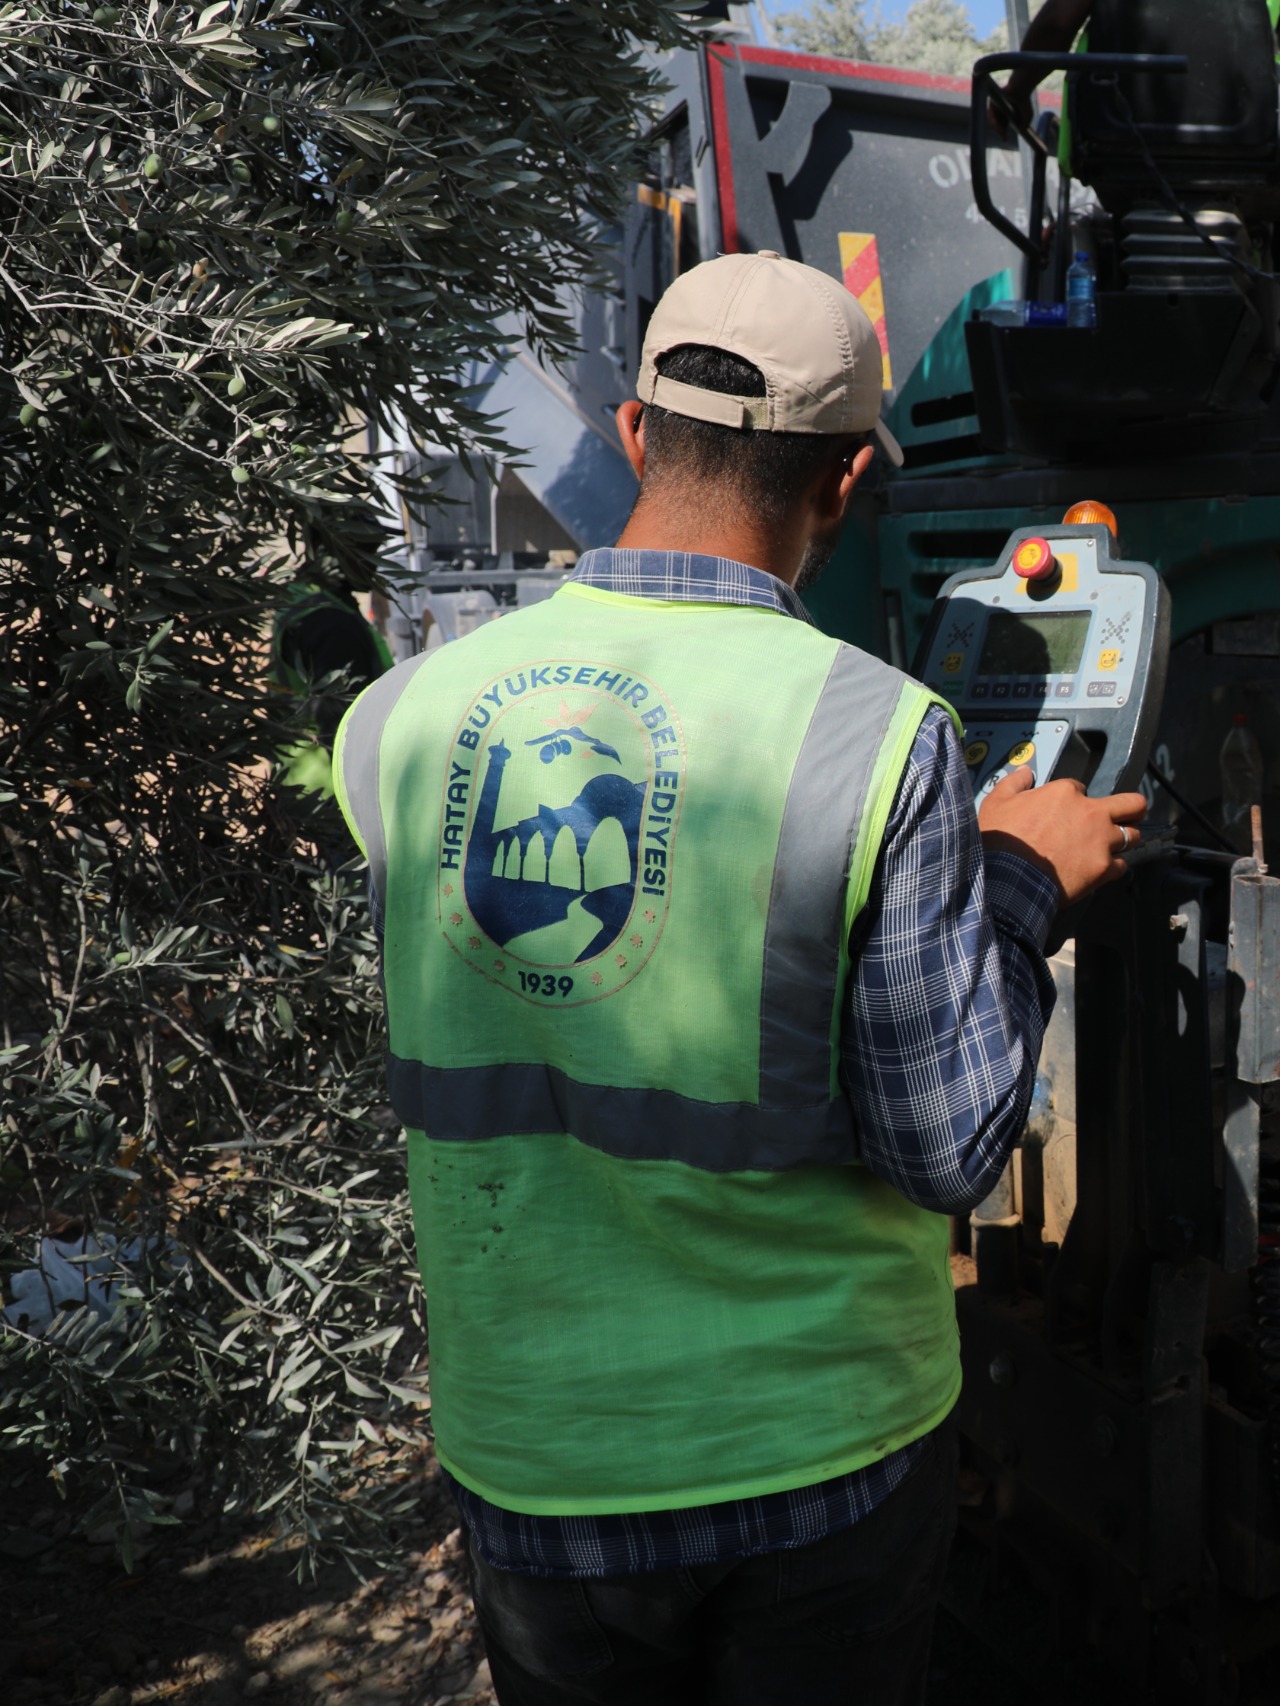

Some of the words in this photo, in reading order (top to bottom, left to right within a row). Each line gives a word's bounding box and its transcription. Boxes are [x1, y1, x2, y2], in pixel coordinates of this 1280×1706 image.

[440, 761, 471, 870] HATAY
[457, 666, 649, 750] BÜYÜKŞEHİR
[640, 705, 679, 896] BELEDİYESİ
[518, 970, 574, 998] 1939
